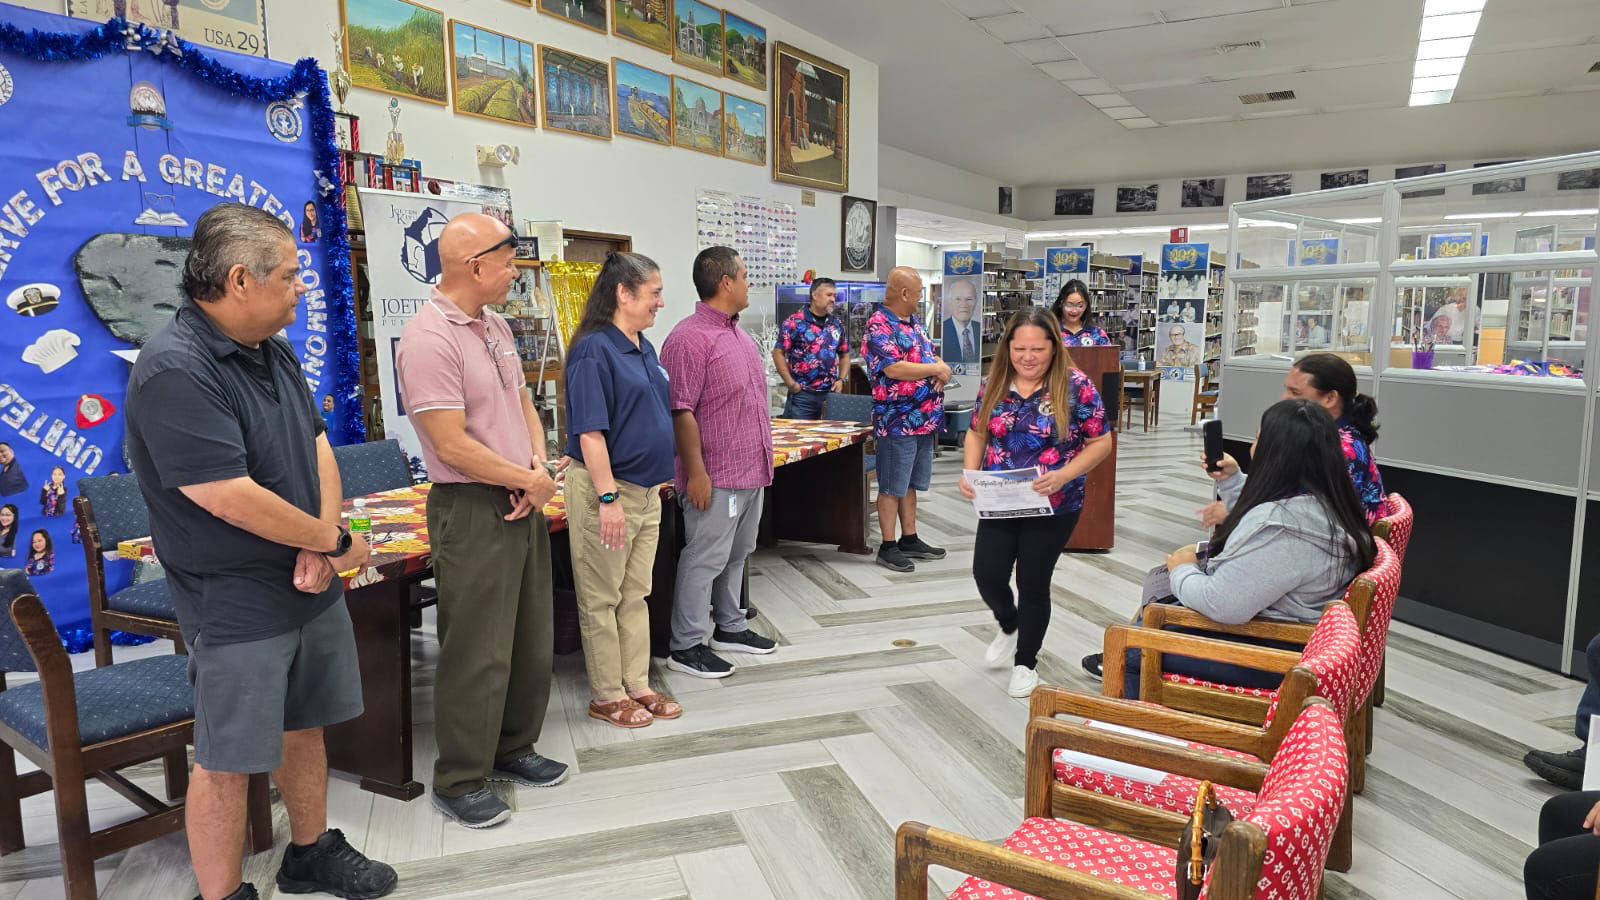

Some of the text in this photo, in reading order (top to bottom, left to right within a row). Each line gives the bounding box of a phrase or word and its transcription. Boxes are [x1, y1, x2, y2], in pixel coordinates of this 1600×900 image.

[204, 27, 259, 55] USA 29
[36, 151, 112, 207] FOR
[121, 149, 147, 182] A
